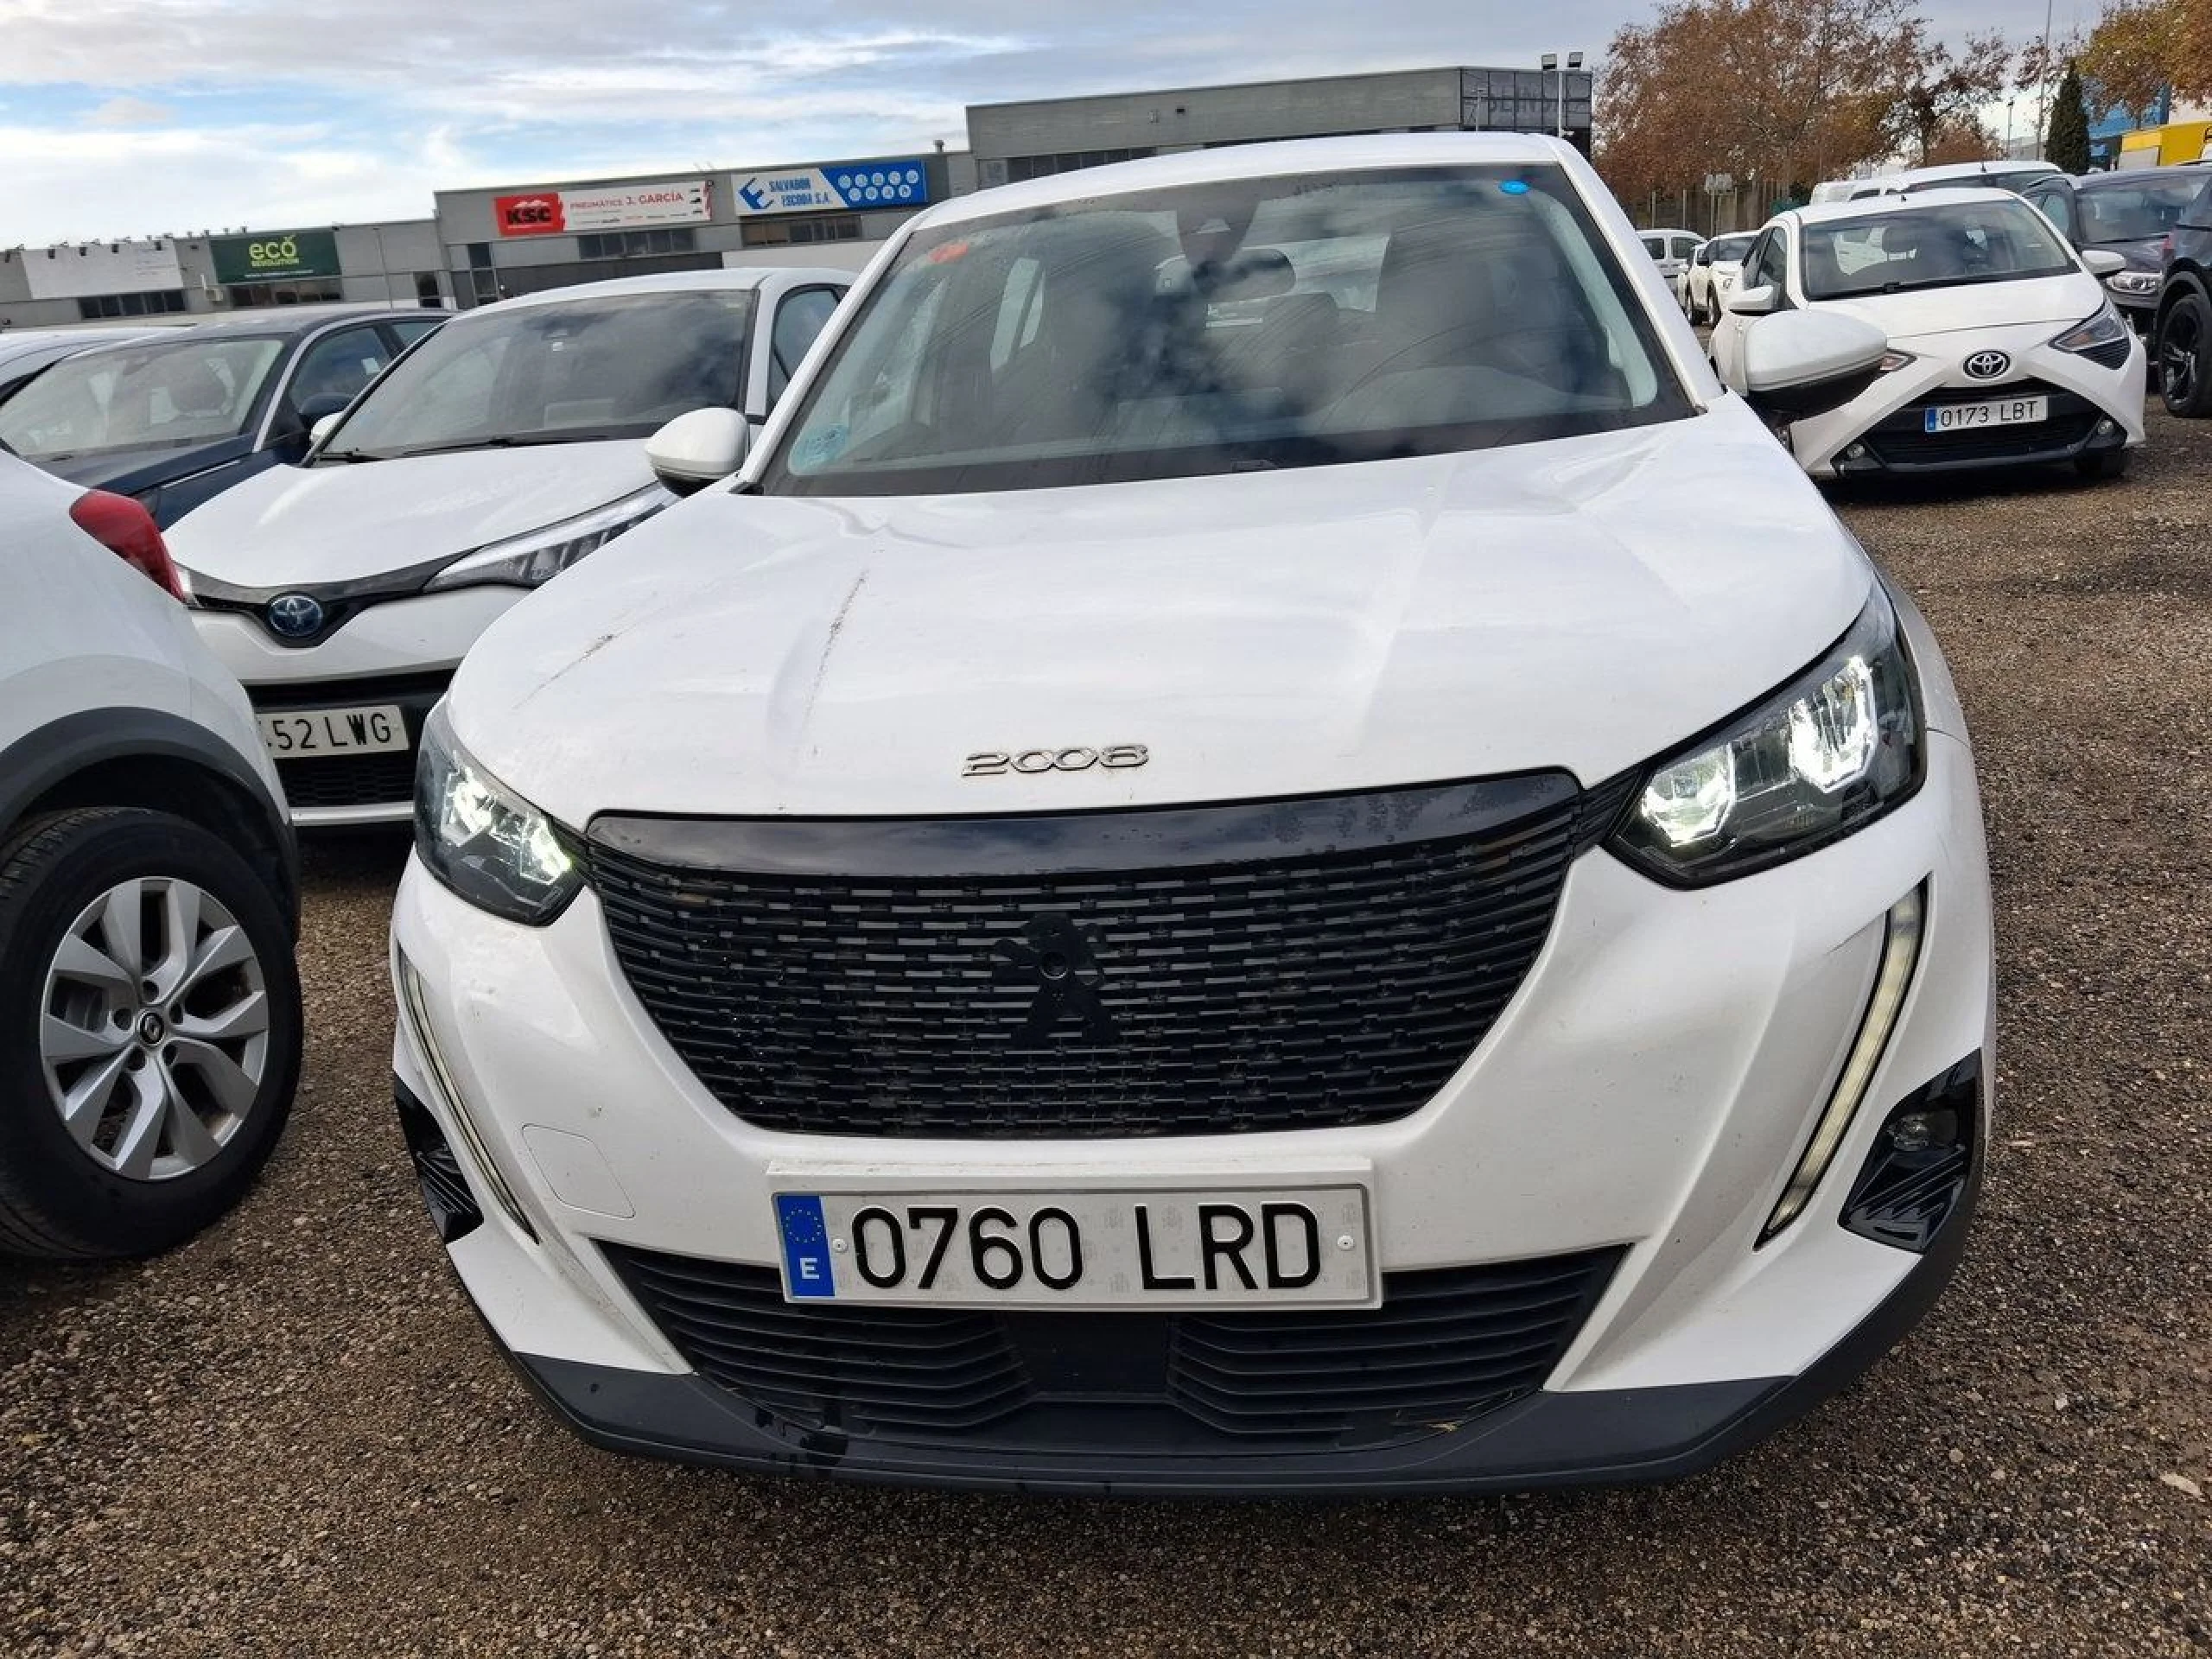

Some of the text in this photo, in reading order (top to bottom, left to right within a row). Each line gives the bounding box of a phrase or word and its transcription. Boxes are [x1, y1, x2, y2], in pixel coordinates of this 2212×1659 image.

[769, 177, 810, 192] SALVADOR
[1942, 401, 2037, 427] 0173 LBT
[259, 713, 391, 750] 52 LWG
[961, 744, 1149, 778] 2008
[851, 1202, 1322, 1292] 0760 LRD
[799, 1258, 820, 1280] E
